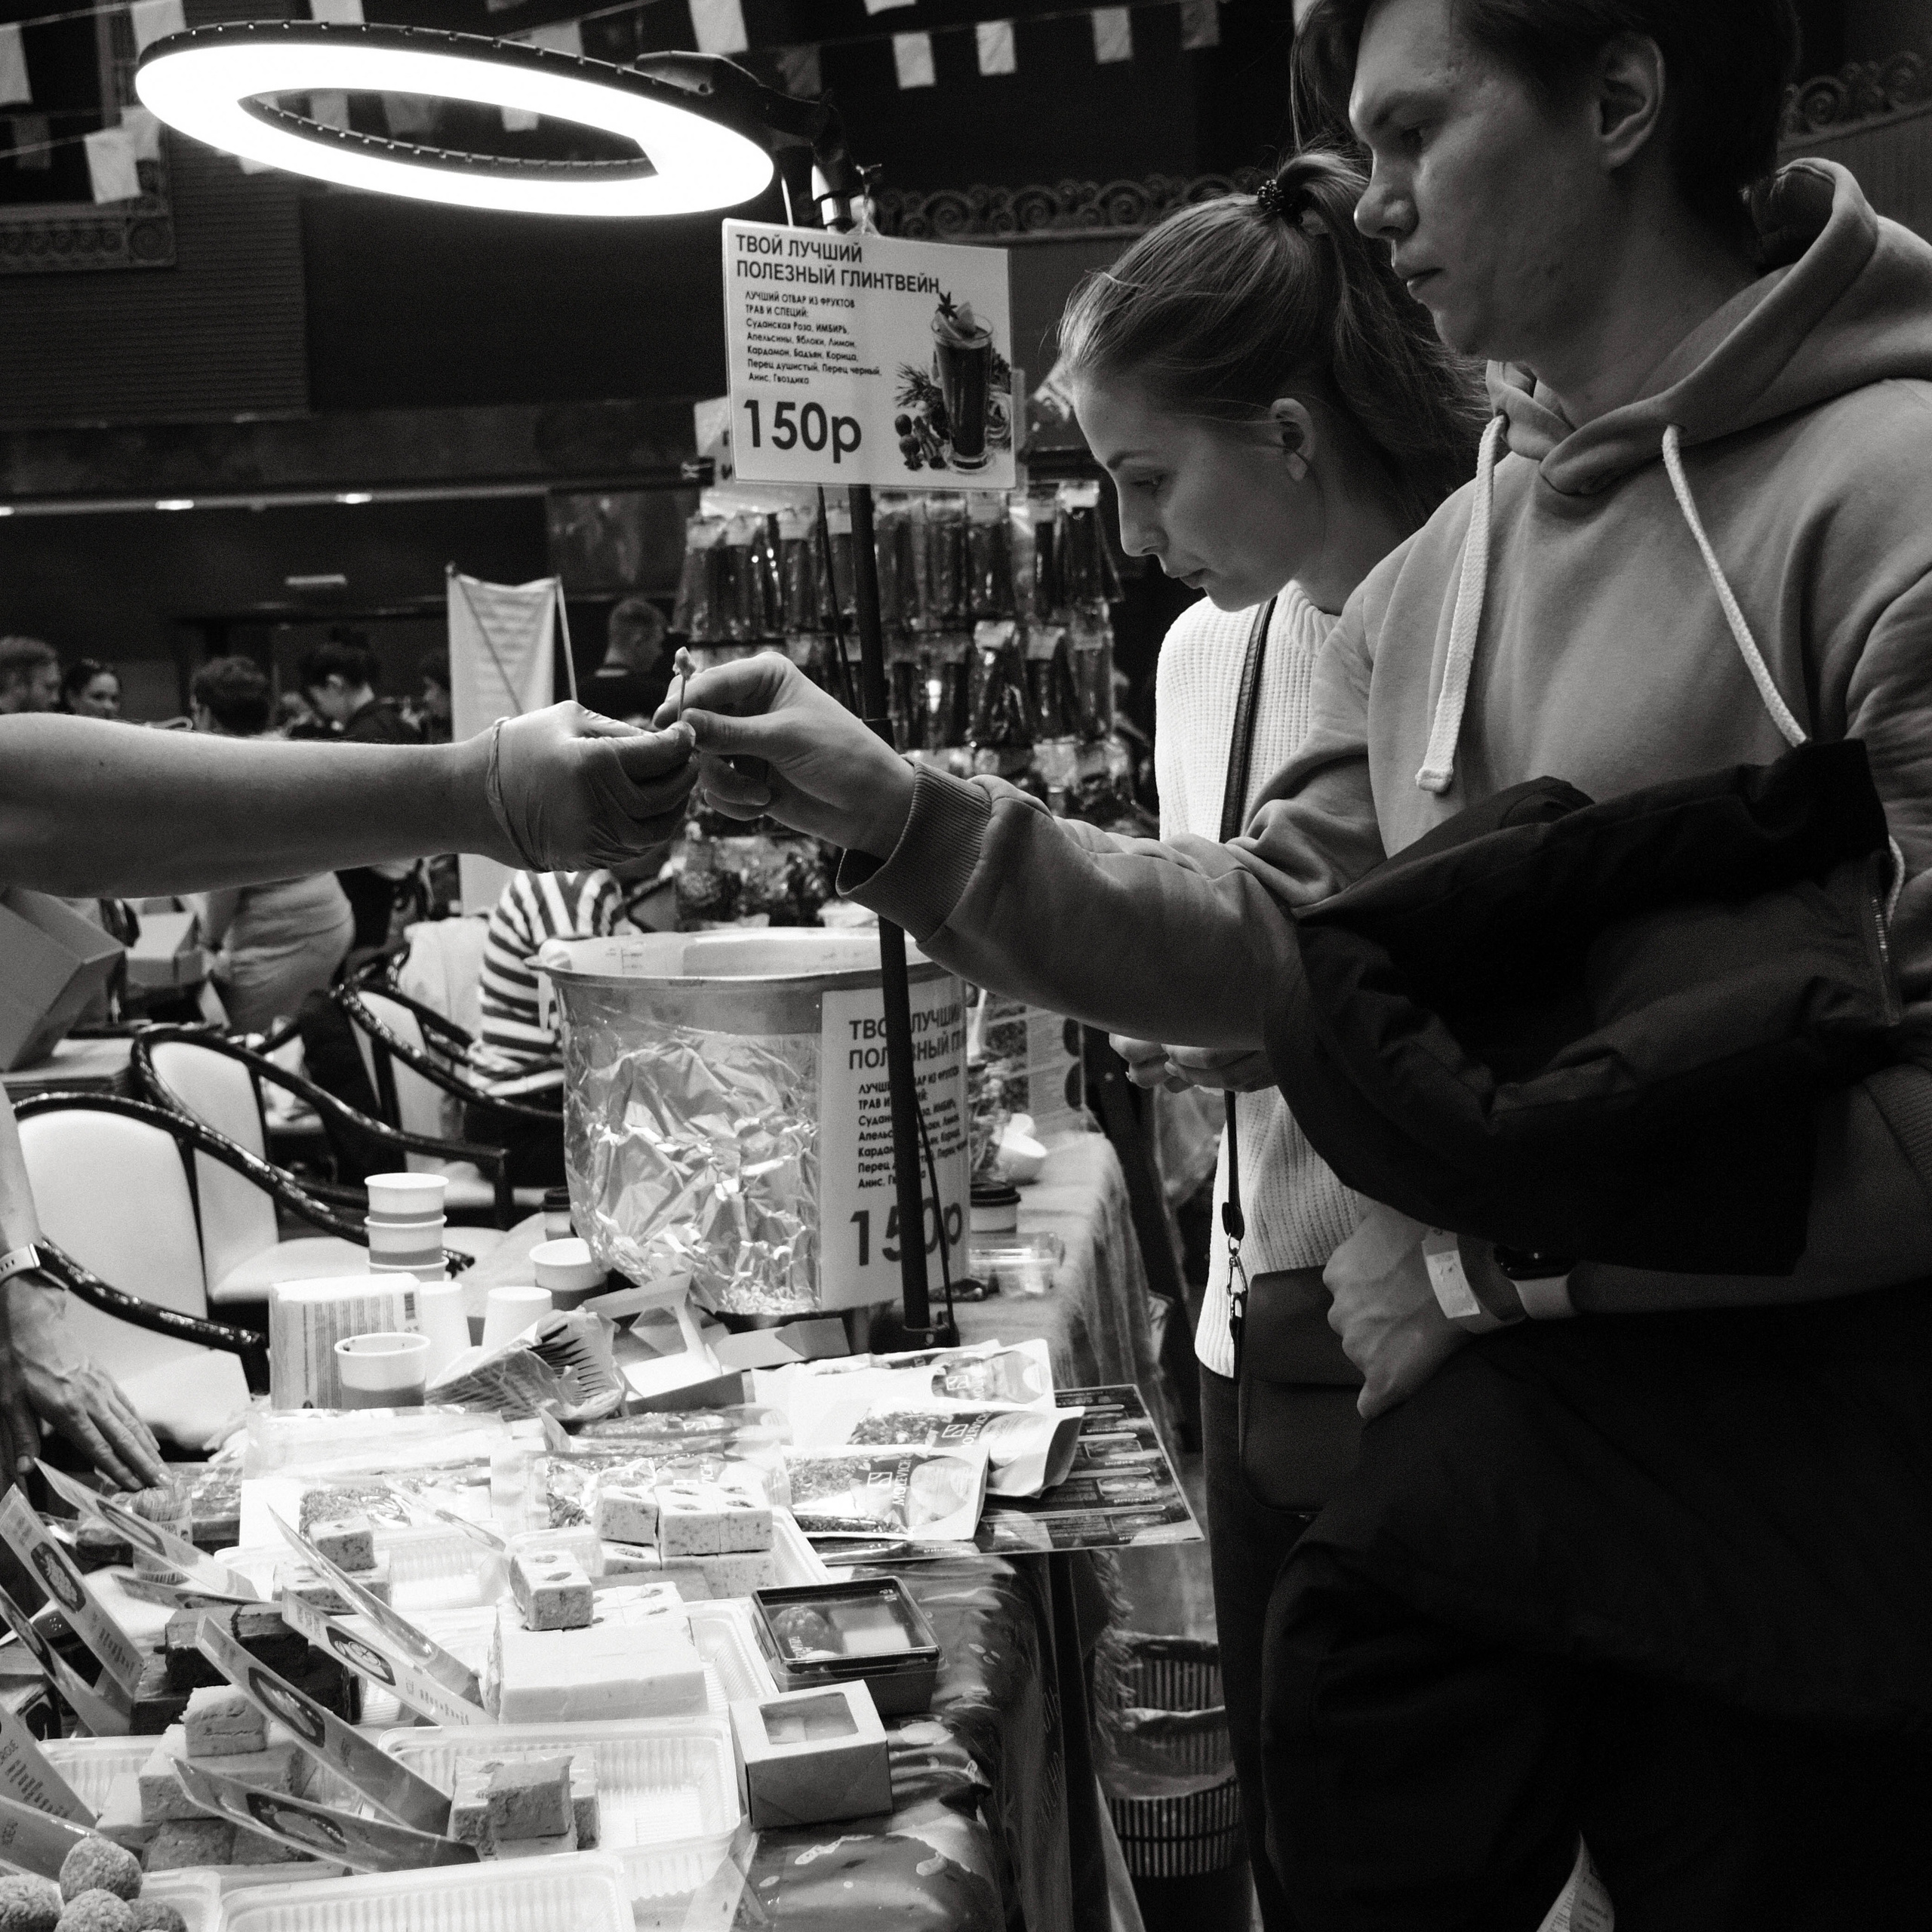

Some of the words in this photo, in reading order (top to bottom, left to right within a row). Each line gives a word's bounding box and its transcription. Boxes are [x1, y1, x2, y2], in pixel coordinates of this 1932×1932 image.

[737, 234, 783, 256] ТВОЙ
[788, 239, 863, 263] ЛУЧШИЙ
[737, 260, 835, 286] ПОЛЕЗНЫЙ
[841, 269, 940, 294] ГЛИНТВЕЙН
[745, 291, 780, 302] ЛУЧШИЙ
[782, 294, 806, 303] ОТВАР
[809, 296, 818, 306] ИЗ
[820, 297, 855, 309] ФРУКТОВ
[746, 303, 764, 314] ТРАВ
[767, 306, 772, 315] И
[746, 318, 791, 329] Суданская
[748, 358, 774, 370] Перец
[823, 363, 848, 375] Перец
[774, 374, 809, 384] Гвоздика
[743, 399, 862, 464] 150р
[849, 1017, 886, 1040] ТВО
[849, 1030, 949, 1069] ПОЛНЫЙ
[859, 1098, 881, 1110] ТРАВ
[858, 1161, 891, 1174] Перец
[892, 1460, 912, 1506] MOLEVICH
